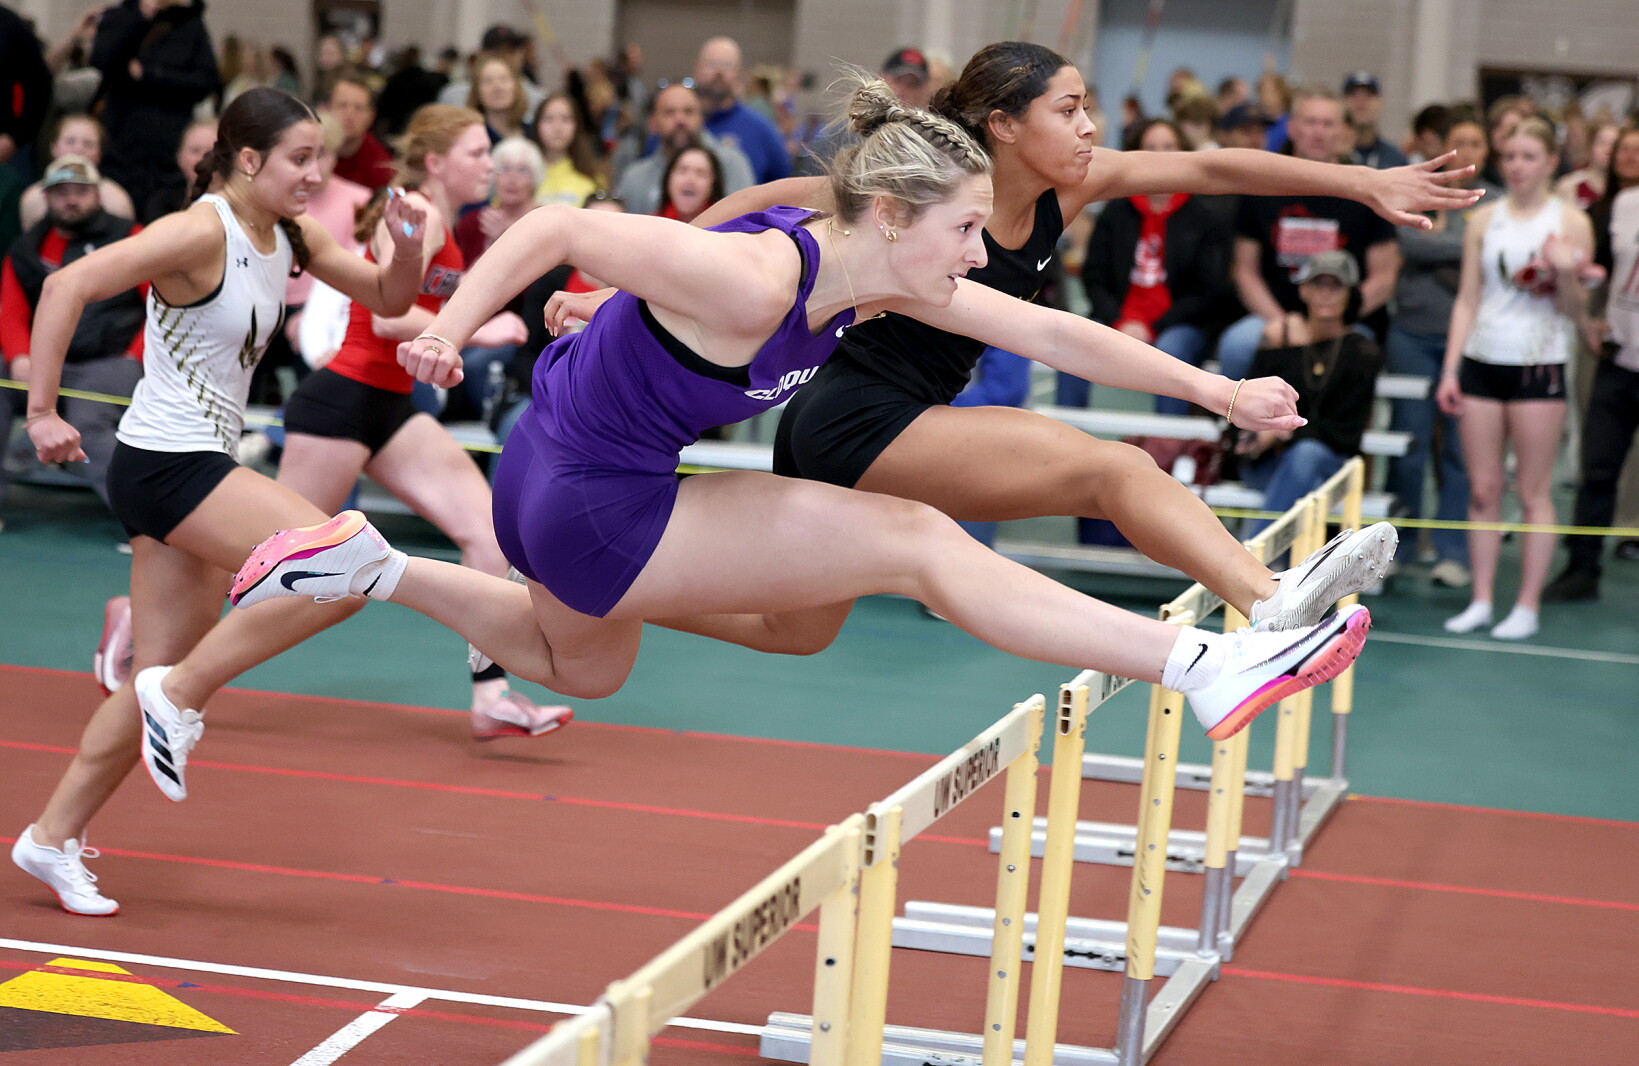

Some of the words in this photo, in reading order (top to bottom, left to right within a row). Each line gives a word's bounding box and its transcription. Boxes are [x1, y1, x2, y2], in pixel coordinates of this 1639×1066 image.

[934, 771, 952, 818] UW
[953, 737, 999, 804] SUPERIOR
[703, 930, 728, 988] UW
[731, 876, 800, 967] SUPERIOR
